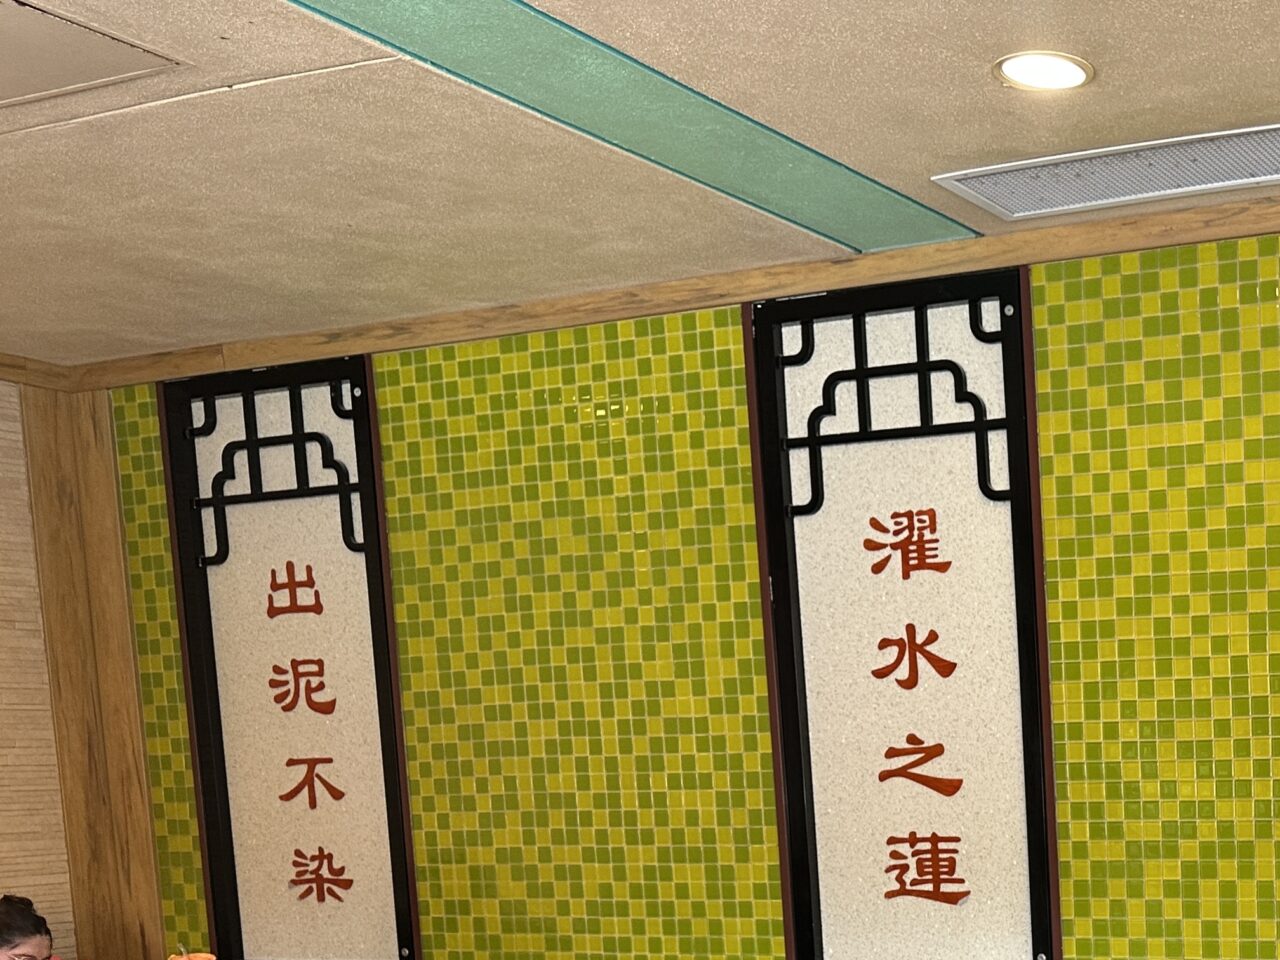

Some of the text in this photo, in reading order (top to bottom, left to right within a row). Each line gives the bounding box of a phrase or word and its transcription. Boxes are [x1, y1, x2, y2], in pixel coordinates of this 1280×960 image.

[266, 560, 354, 903] 出泥不染
[863, 507, 971, 905] 濯水之蓮
